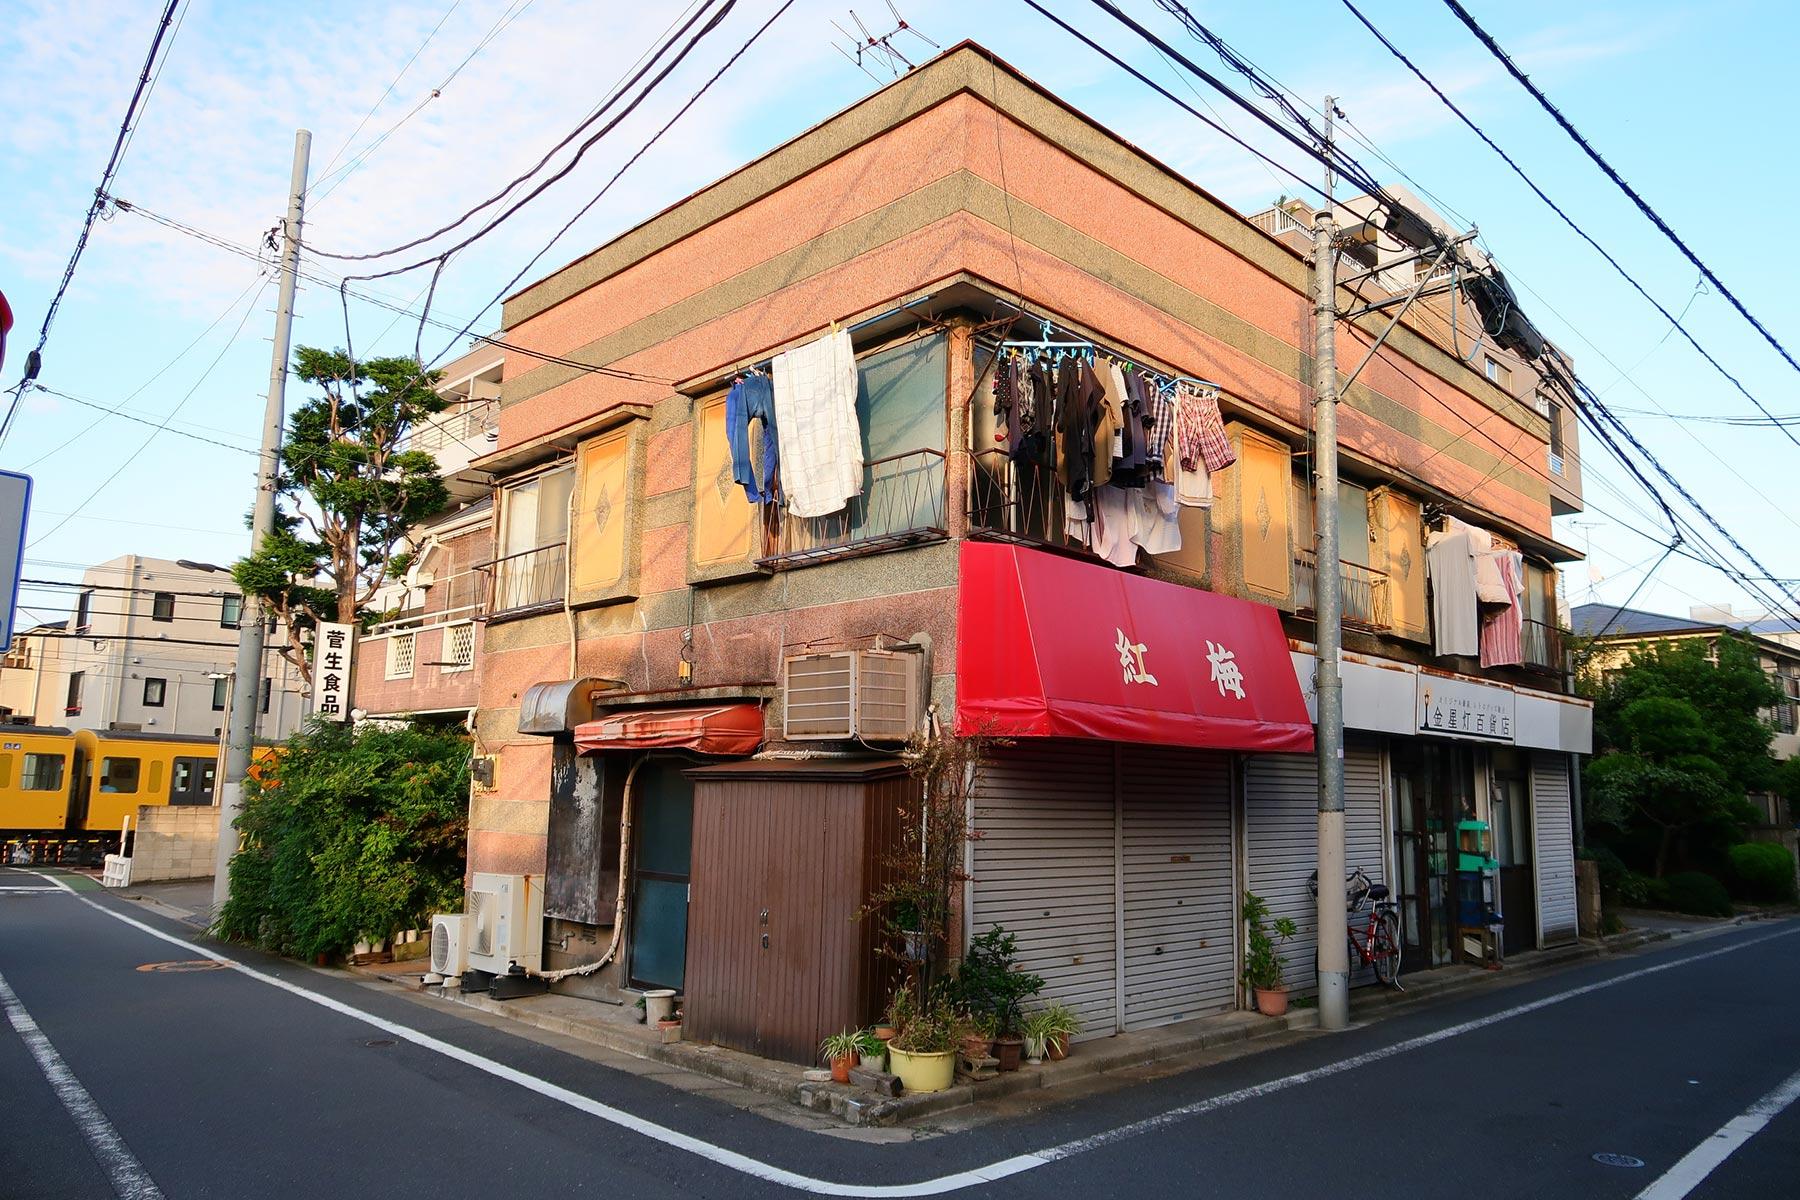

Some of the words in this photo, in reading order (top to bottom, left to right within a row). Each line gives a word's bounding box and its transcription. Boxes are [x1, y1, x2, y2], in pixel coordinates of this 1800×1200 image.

[321, 630, 346, 714] 菅生食品
[1114, 627, 1247, 700] 紅梅
